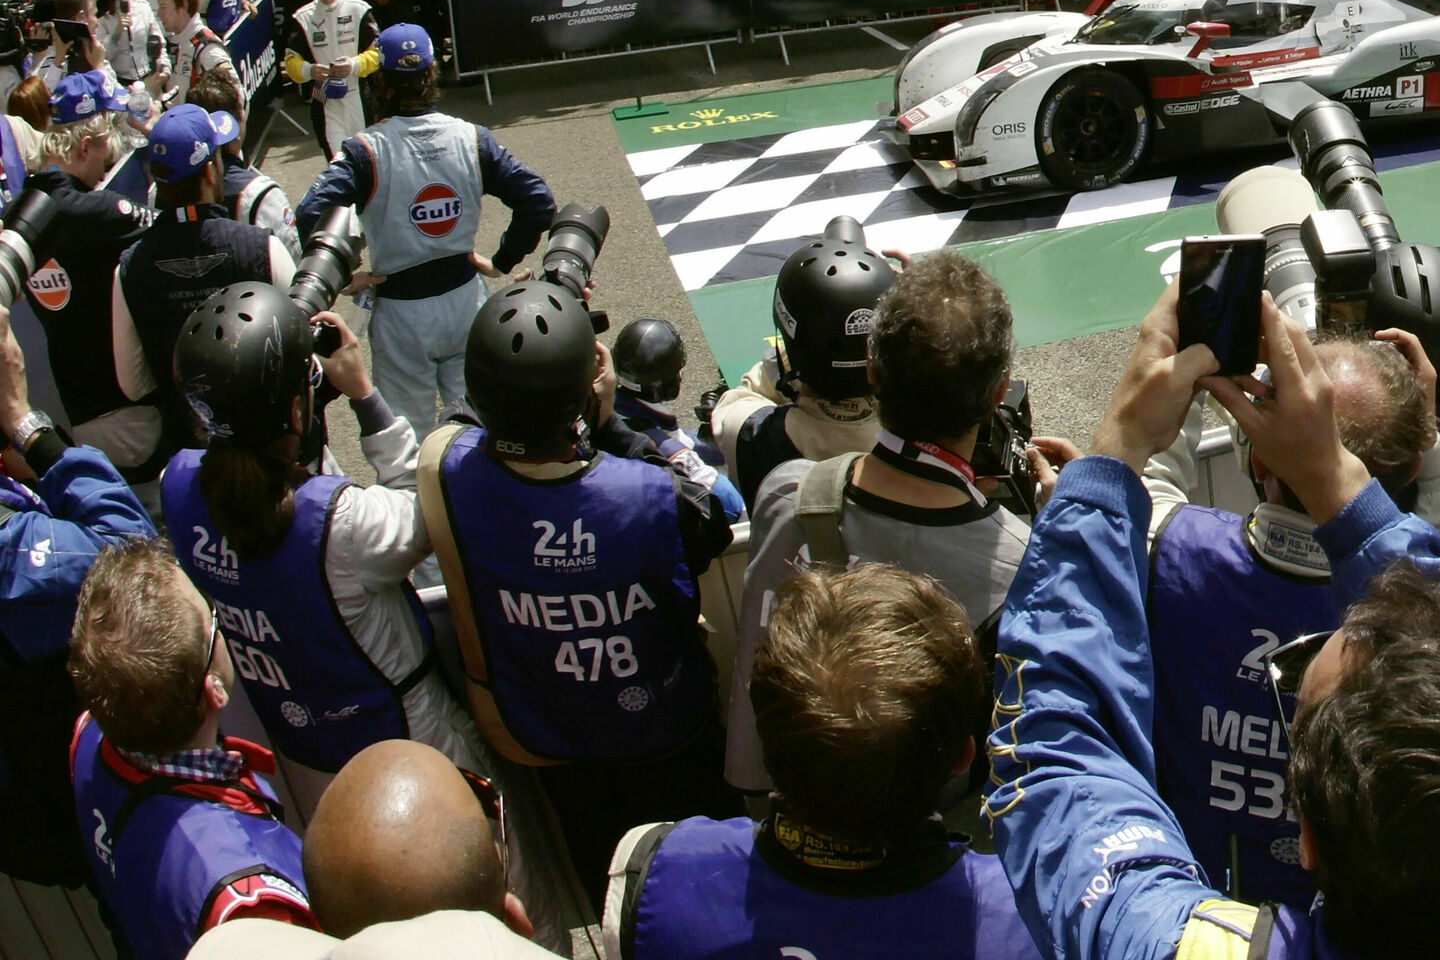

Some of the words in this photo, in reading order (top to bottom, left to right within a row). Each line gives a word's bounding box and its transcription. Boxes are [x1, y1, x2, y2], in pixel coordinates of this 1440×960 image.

[531, 15, 546, 23] FIA
[548, 11, 579, 21] WORLD
[580, 2, 638, 17] ENDURANCE
[568, 11, 636, 26] CHAMPIONSHIP
[1211, 78, 1228, 86] Audi
[1230, 76, 1249, 85] Sport
[1401, 78, 1419, 95] P1
[1342, 85, 1392, 100] AETHRA
[1173, 103, 1198, 113] Castrol
[1200, 94, 1241, 110] EDGE
[650, 109, 779, 134] ROLEX
[992, 122, 1026, 136] ORIS
[411, 200, 461, 221] Gulf
[496, 440, 526, 456] EOS
[532, 517, 596, 557] 24h
[193, 525, 238, 569] 24h
[534, 557, 551, 568] LE
[554, 555, 597, 569] MANS
[207, 566, 240, 580] MANS
[499, 582, 657, 632] MEDIA
[214, 599, 281, 642] EDIA
[554, 635, 639, 682] 478
